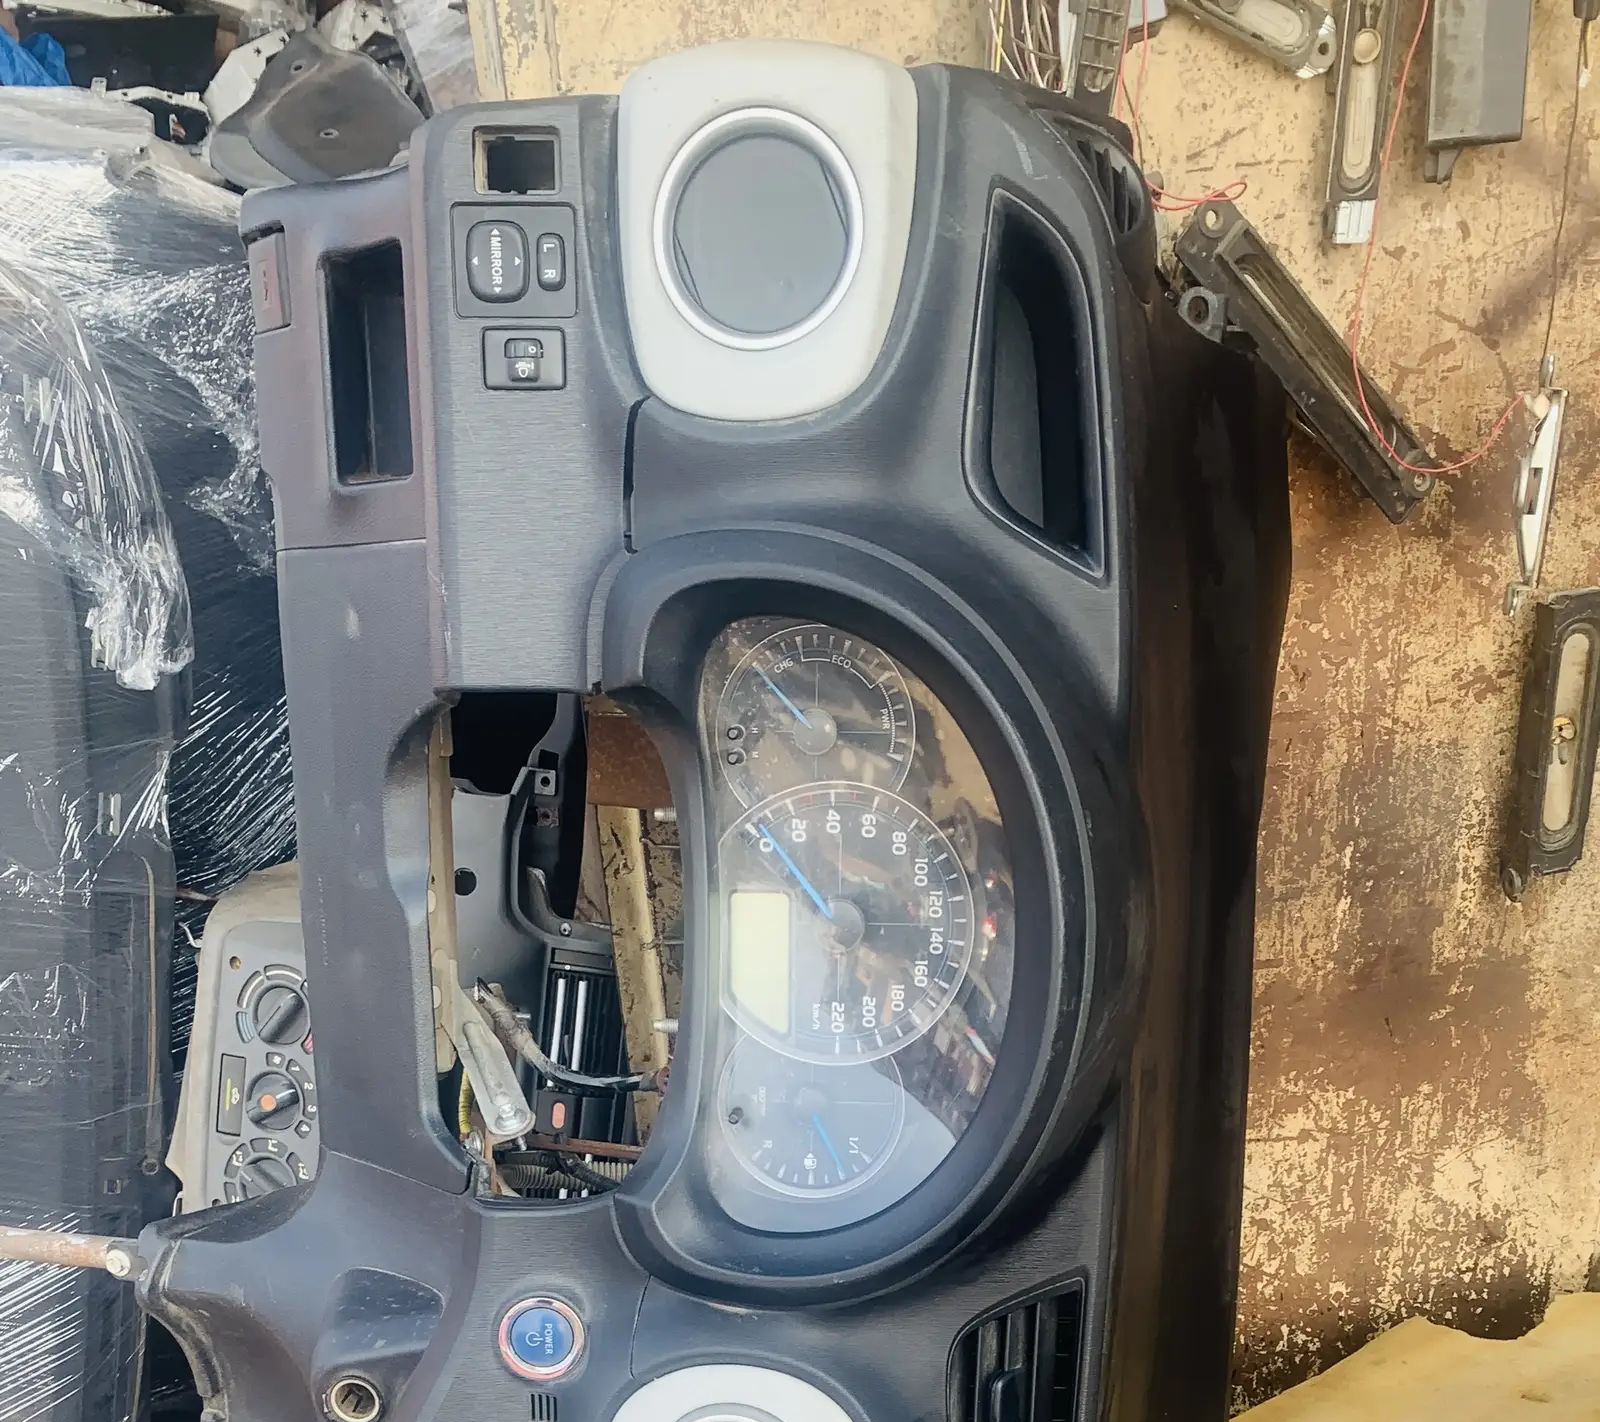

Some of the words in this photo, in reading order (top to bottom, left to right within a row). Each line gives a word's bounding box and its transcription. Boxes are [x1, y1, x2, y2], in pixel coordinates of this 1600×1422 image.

[543, 244, 555, 252] L
[490, 236, 503, 285] MIRROR
[543, 269, 556, 278] R
[774, 658, 794, 674] CHG
[831, 654, 852, 669] ECO
[879, 708, 891, 730] PWR
[791, 818, 807, 842] 20
[826, 810, 841, 834] 40
[861, 814, 877, 838] 60
[759, 838, 774, 853] 0
[892, 831, 907, 856] 80
[914, 857, 929, 887] 100
[929, 890, 944, 918] 120
[929, 927, 944, 955] 140
[914, 960, 929, 987] 160
[891, 984, 905, 1011] 180
[812, 1003, 821, 1030] km/h
[831, 1001, 845, 1033] 220
[862, 996, 876, 1028] 200
[304, 1082, 314, 1091] 2
[307, 1104, 317, 1113] 3
[301, 1124, 310, 1132] 4
[848, 1136, 859, 1154] 1/1
[544, 1323, 554, 1355] POWER
